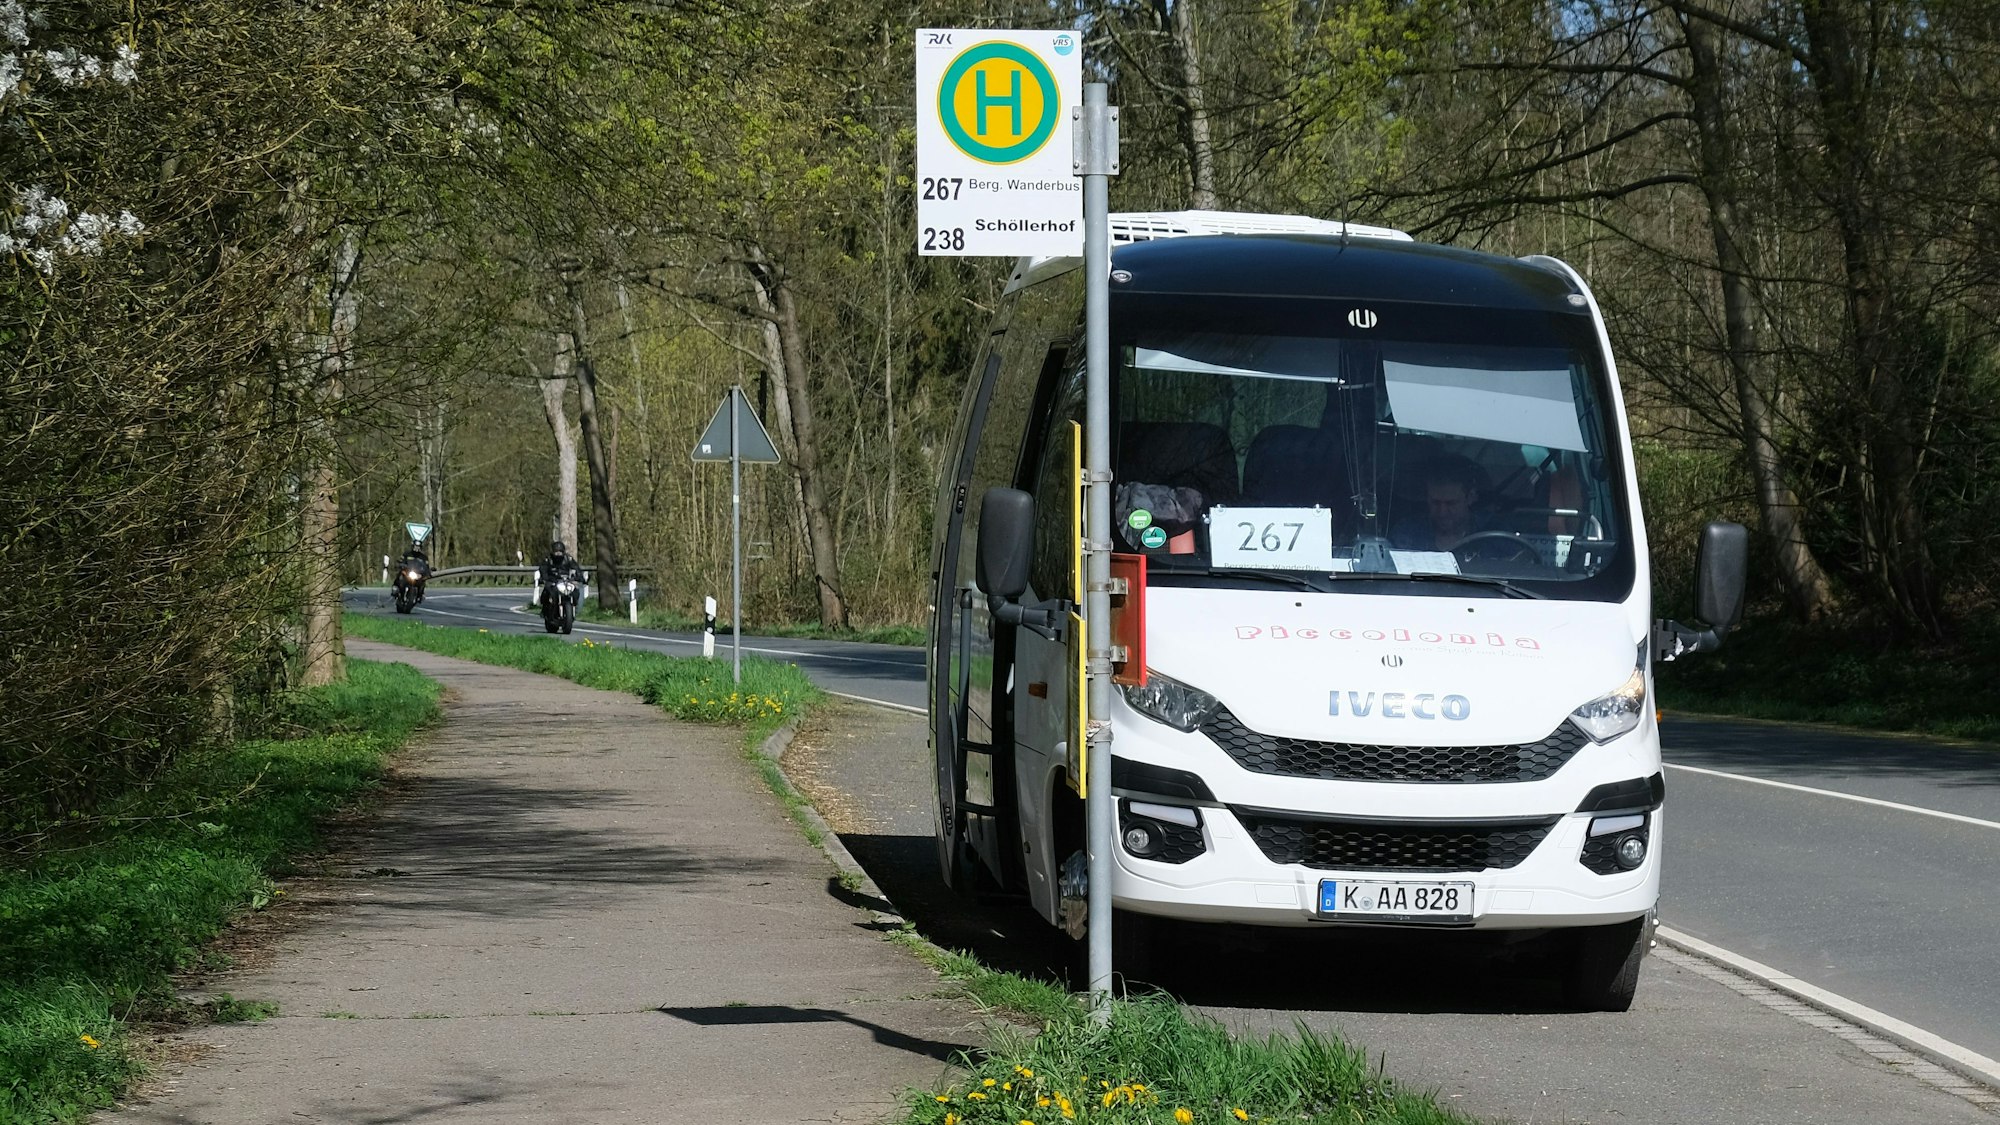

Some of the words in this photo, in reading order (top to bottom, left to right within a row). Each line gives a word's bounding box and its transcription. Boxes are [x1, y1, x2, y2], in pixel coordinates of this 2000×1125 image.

[1052, 37, 1069, 47] VRS
[976, 69, 1022, 136] H
[922, 177, 963, 201] 267
[969, 178, 1003, 193] Berg.
[1007, 179, 1080, 192] Wanderbus
[975, 218, 1076, 232] Schöllerhof
[923, 227, 965, 251] 238
[1237, 521, 1304, 552] 267
[1235, 624, 1541, 650] Piccolonia
[1328, 689, 1472, 721] IVECO
[1344, 885, 1359, 909] K
[1377, 886, 1408, 910] AA
[1414, 887, 1459, 911] 828
